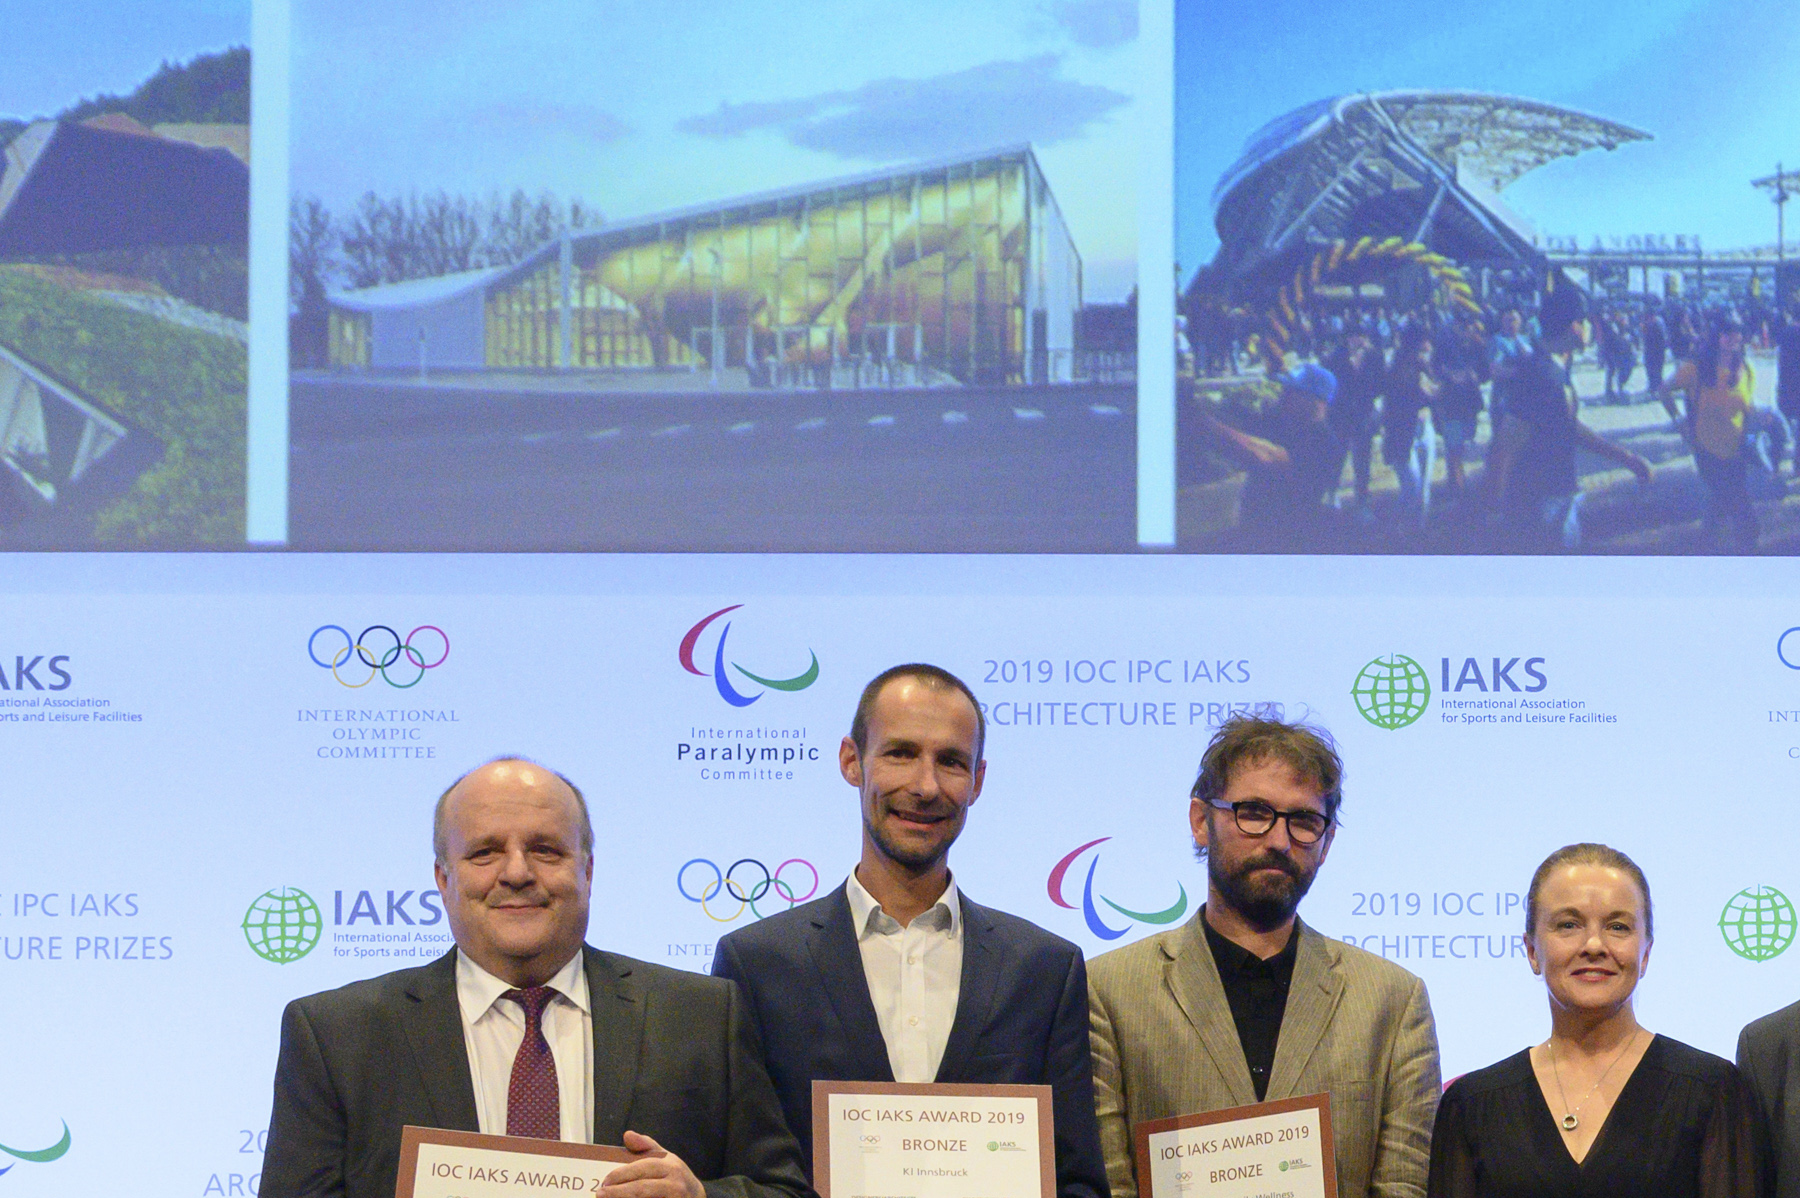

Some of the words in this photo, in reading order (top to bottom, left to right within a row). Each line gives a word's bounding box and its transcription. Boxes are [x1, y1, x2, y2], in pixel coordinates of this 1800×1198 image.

[0, 655, 72, 691] KS
[984, 660, 1053, 683] 2019
[1066, 660, 1116, 683] IOC
[1128, 660, 1172, 683] IPC
[1184, 660, 1250, 683] IAKS
[1442, 657, 1547, 692] IAKS
[43, 697, 110, 707] Association
[1441, 698, 1516, 709] International
[1520, 699, 1586, 709] Association
[22, 712, 45, 722] and
[48, 712, 89, 722] Leisure
[93, 711, 143, 722] Facilities
[298, 709, 459, 722] INTERNATIONAL
[979, 702, 1176, 726] RCHITECTURE
[1441, 712, 1458, 723] for
[1461, 713, 1497, 725] Sports
[1500, 713, 1522, 723] and
[1526, 713, 1566, 723] Leisure
[1569, 713, 1617, 723] Facilities
[332, 728, 420, 740] OLYMPIC
[691, 727, 806, 739] International
[317, 746, 435, 758] COMMITTEE
[678, 743, 818, 764] Paralympic
[701, 768, 793, 780] Committee
[14, 893, 58, 917] IPC
[71, 893, 139, 917] IAKS
[334, 889, 442, 926] IAKS
[1352, 892, 1420, 916] 2019
[1433, 892, 1484, 916] IOC
[334, 932, 411, 942] International
[76, 936, 173, 960] PRIZES
[334, 947, 351, 957] for
[354, 947, 390, 959] Sports
[394, 947, 416, 957] and
[843, 1108, 872, 1121] IOC
[877, 1109, 914, 1123] IAKS
[918, 1110, 982, 1124] AWARD
[987, 1112, 1025, 1125] 2019
[902, 1138, 967, 1153] BRONZE
[1161, 1144, 1184, 1161] IOC
[1188, 1139, 1218, 1156] IAKS
[1222, 1130, 1274, 1150] AWARD
[1278, 1124, 1310, 1143] 2019
[431, 1162, 464, 1180] IOC
[468, 1166, 509, 1185] IAKS
[514, 1170, 585, 1192] AWARD
[903, 1168, 914, 1177] KI
[917, 1167, 969, 1178] Innsbruck
[1210, 1163, 1263, 1184] BRONZE
